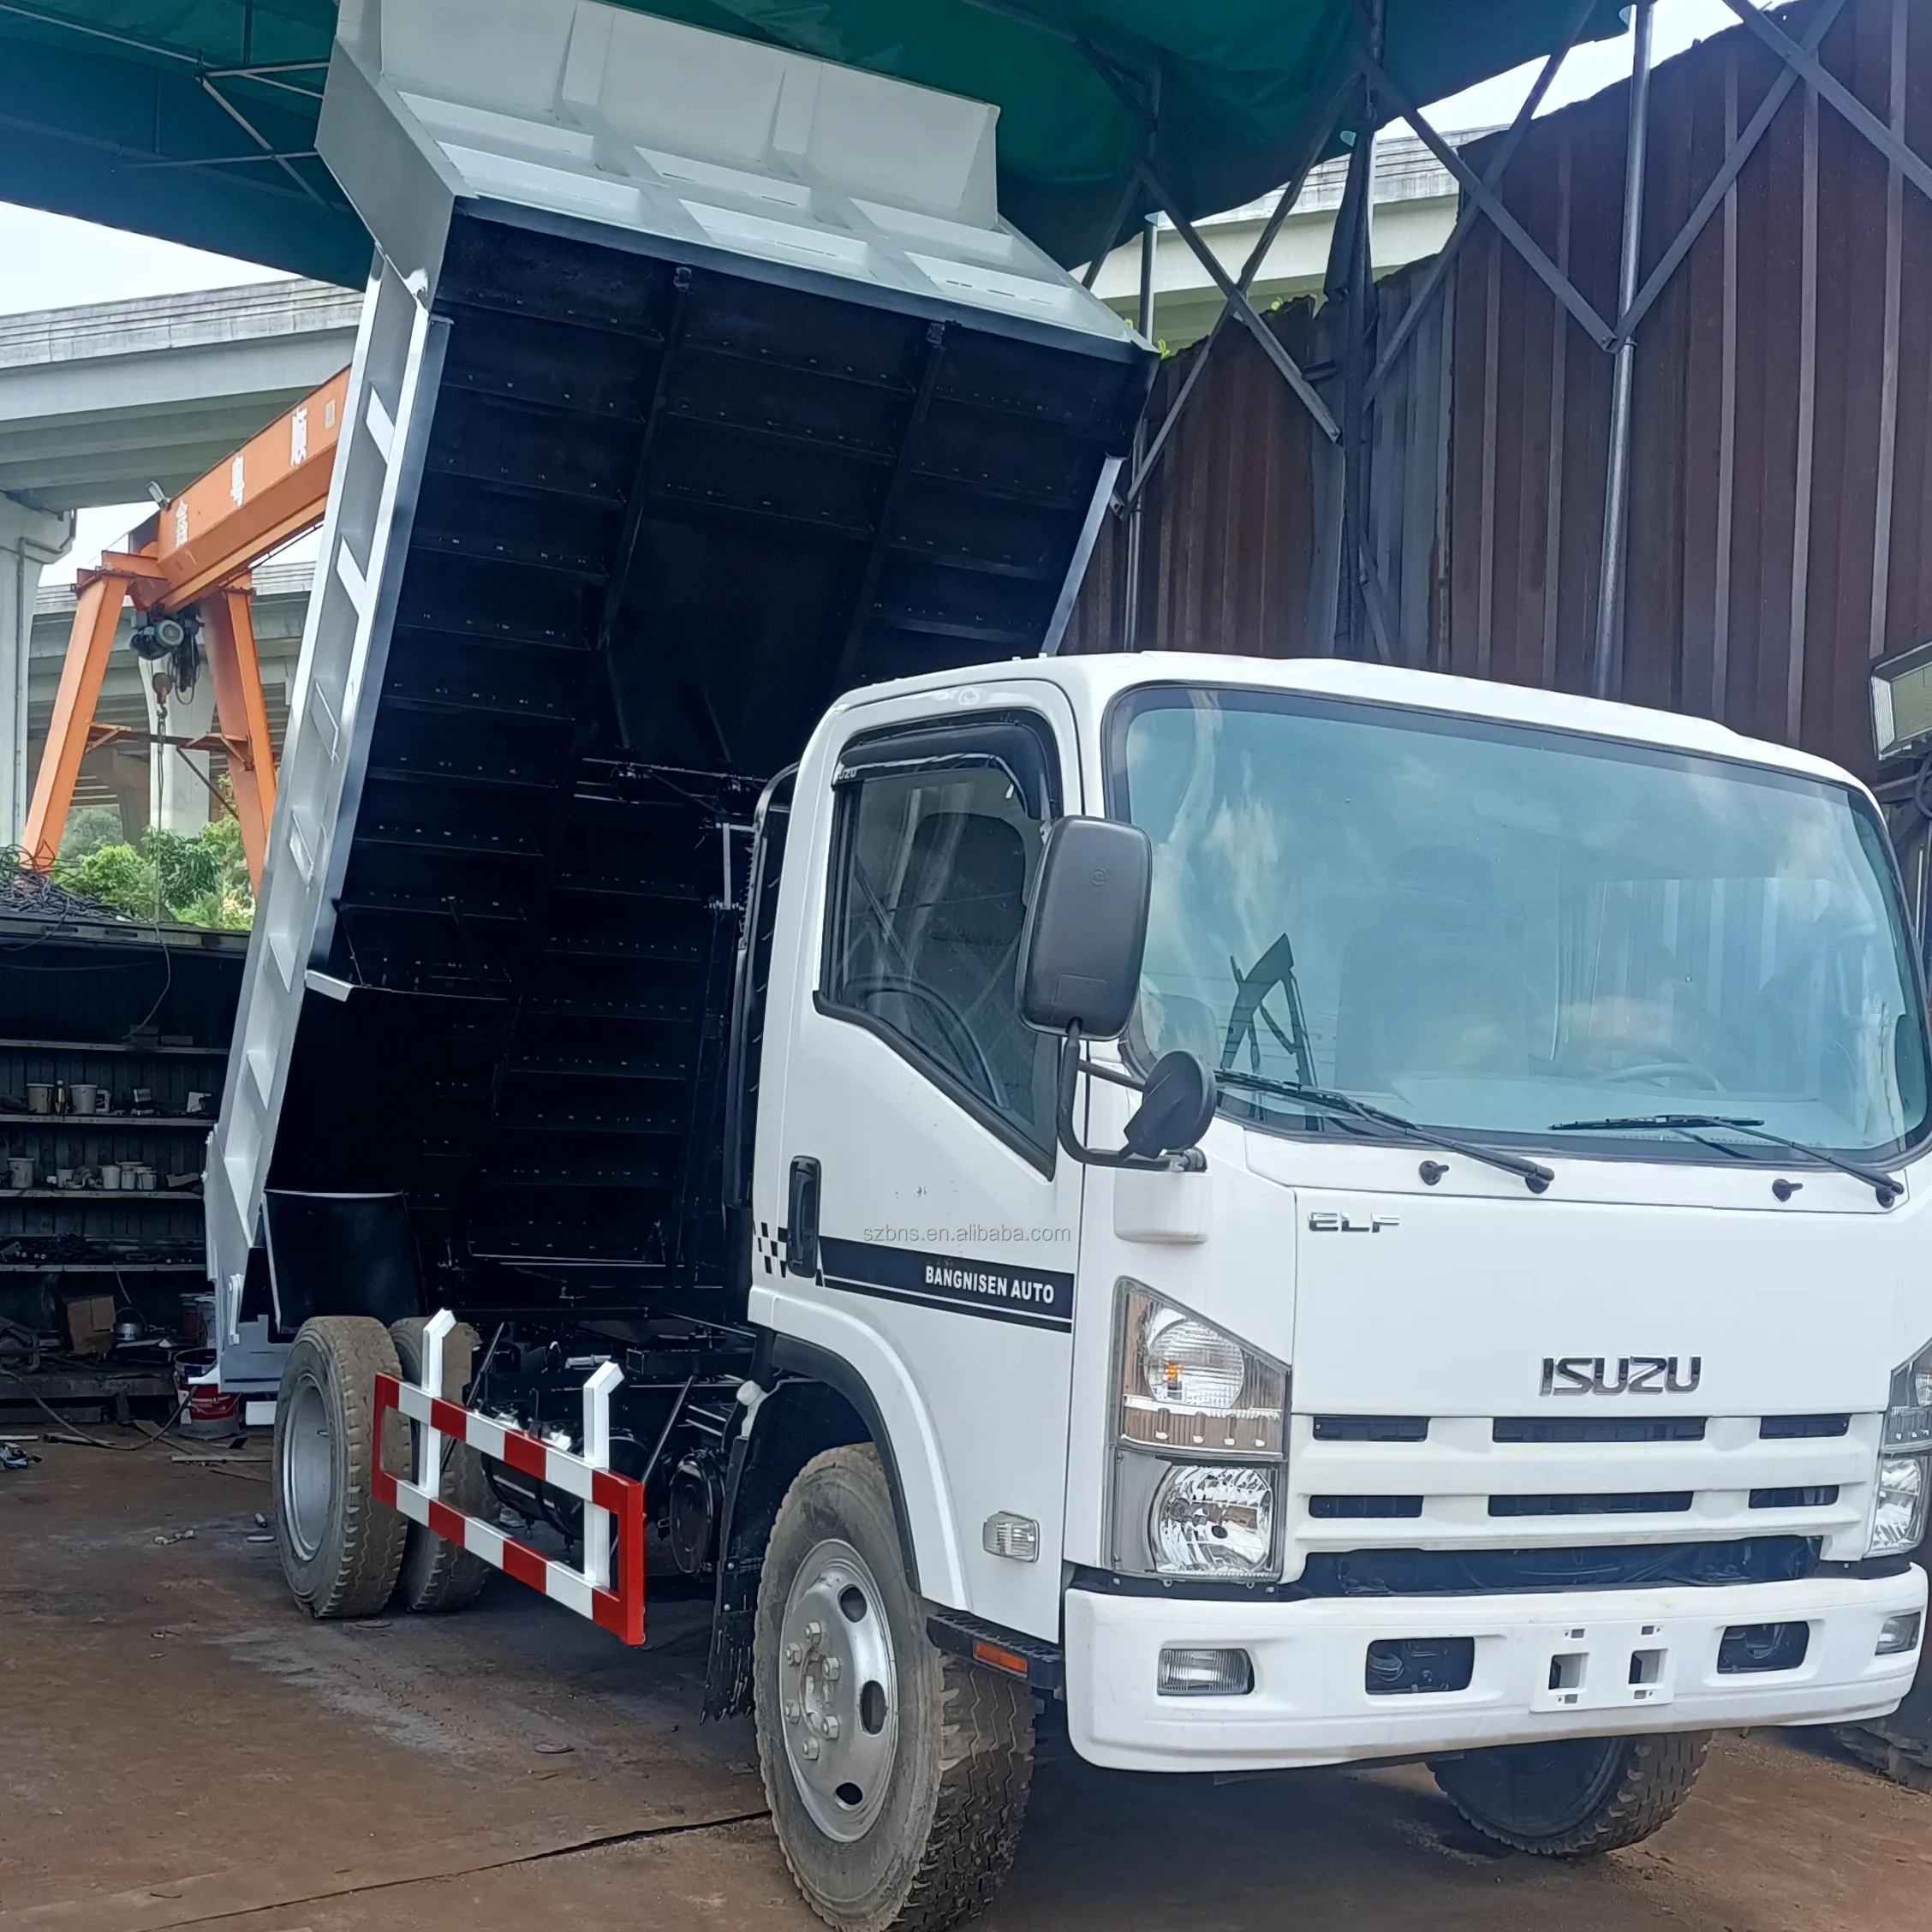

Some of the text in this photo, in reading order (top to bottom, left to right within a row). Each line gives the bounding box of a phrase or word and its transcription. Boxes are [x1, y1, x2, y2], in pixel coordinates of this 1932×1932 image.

[1309, 1211, 1400, 1233] ELF
[925, 1265, 1054, 1304] BANGNISEN AUTO
[1539, 1354, 1702, 1397] ISUZU
